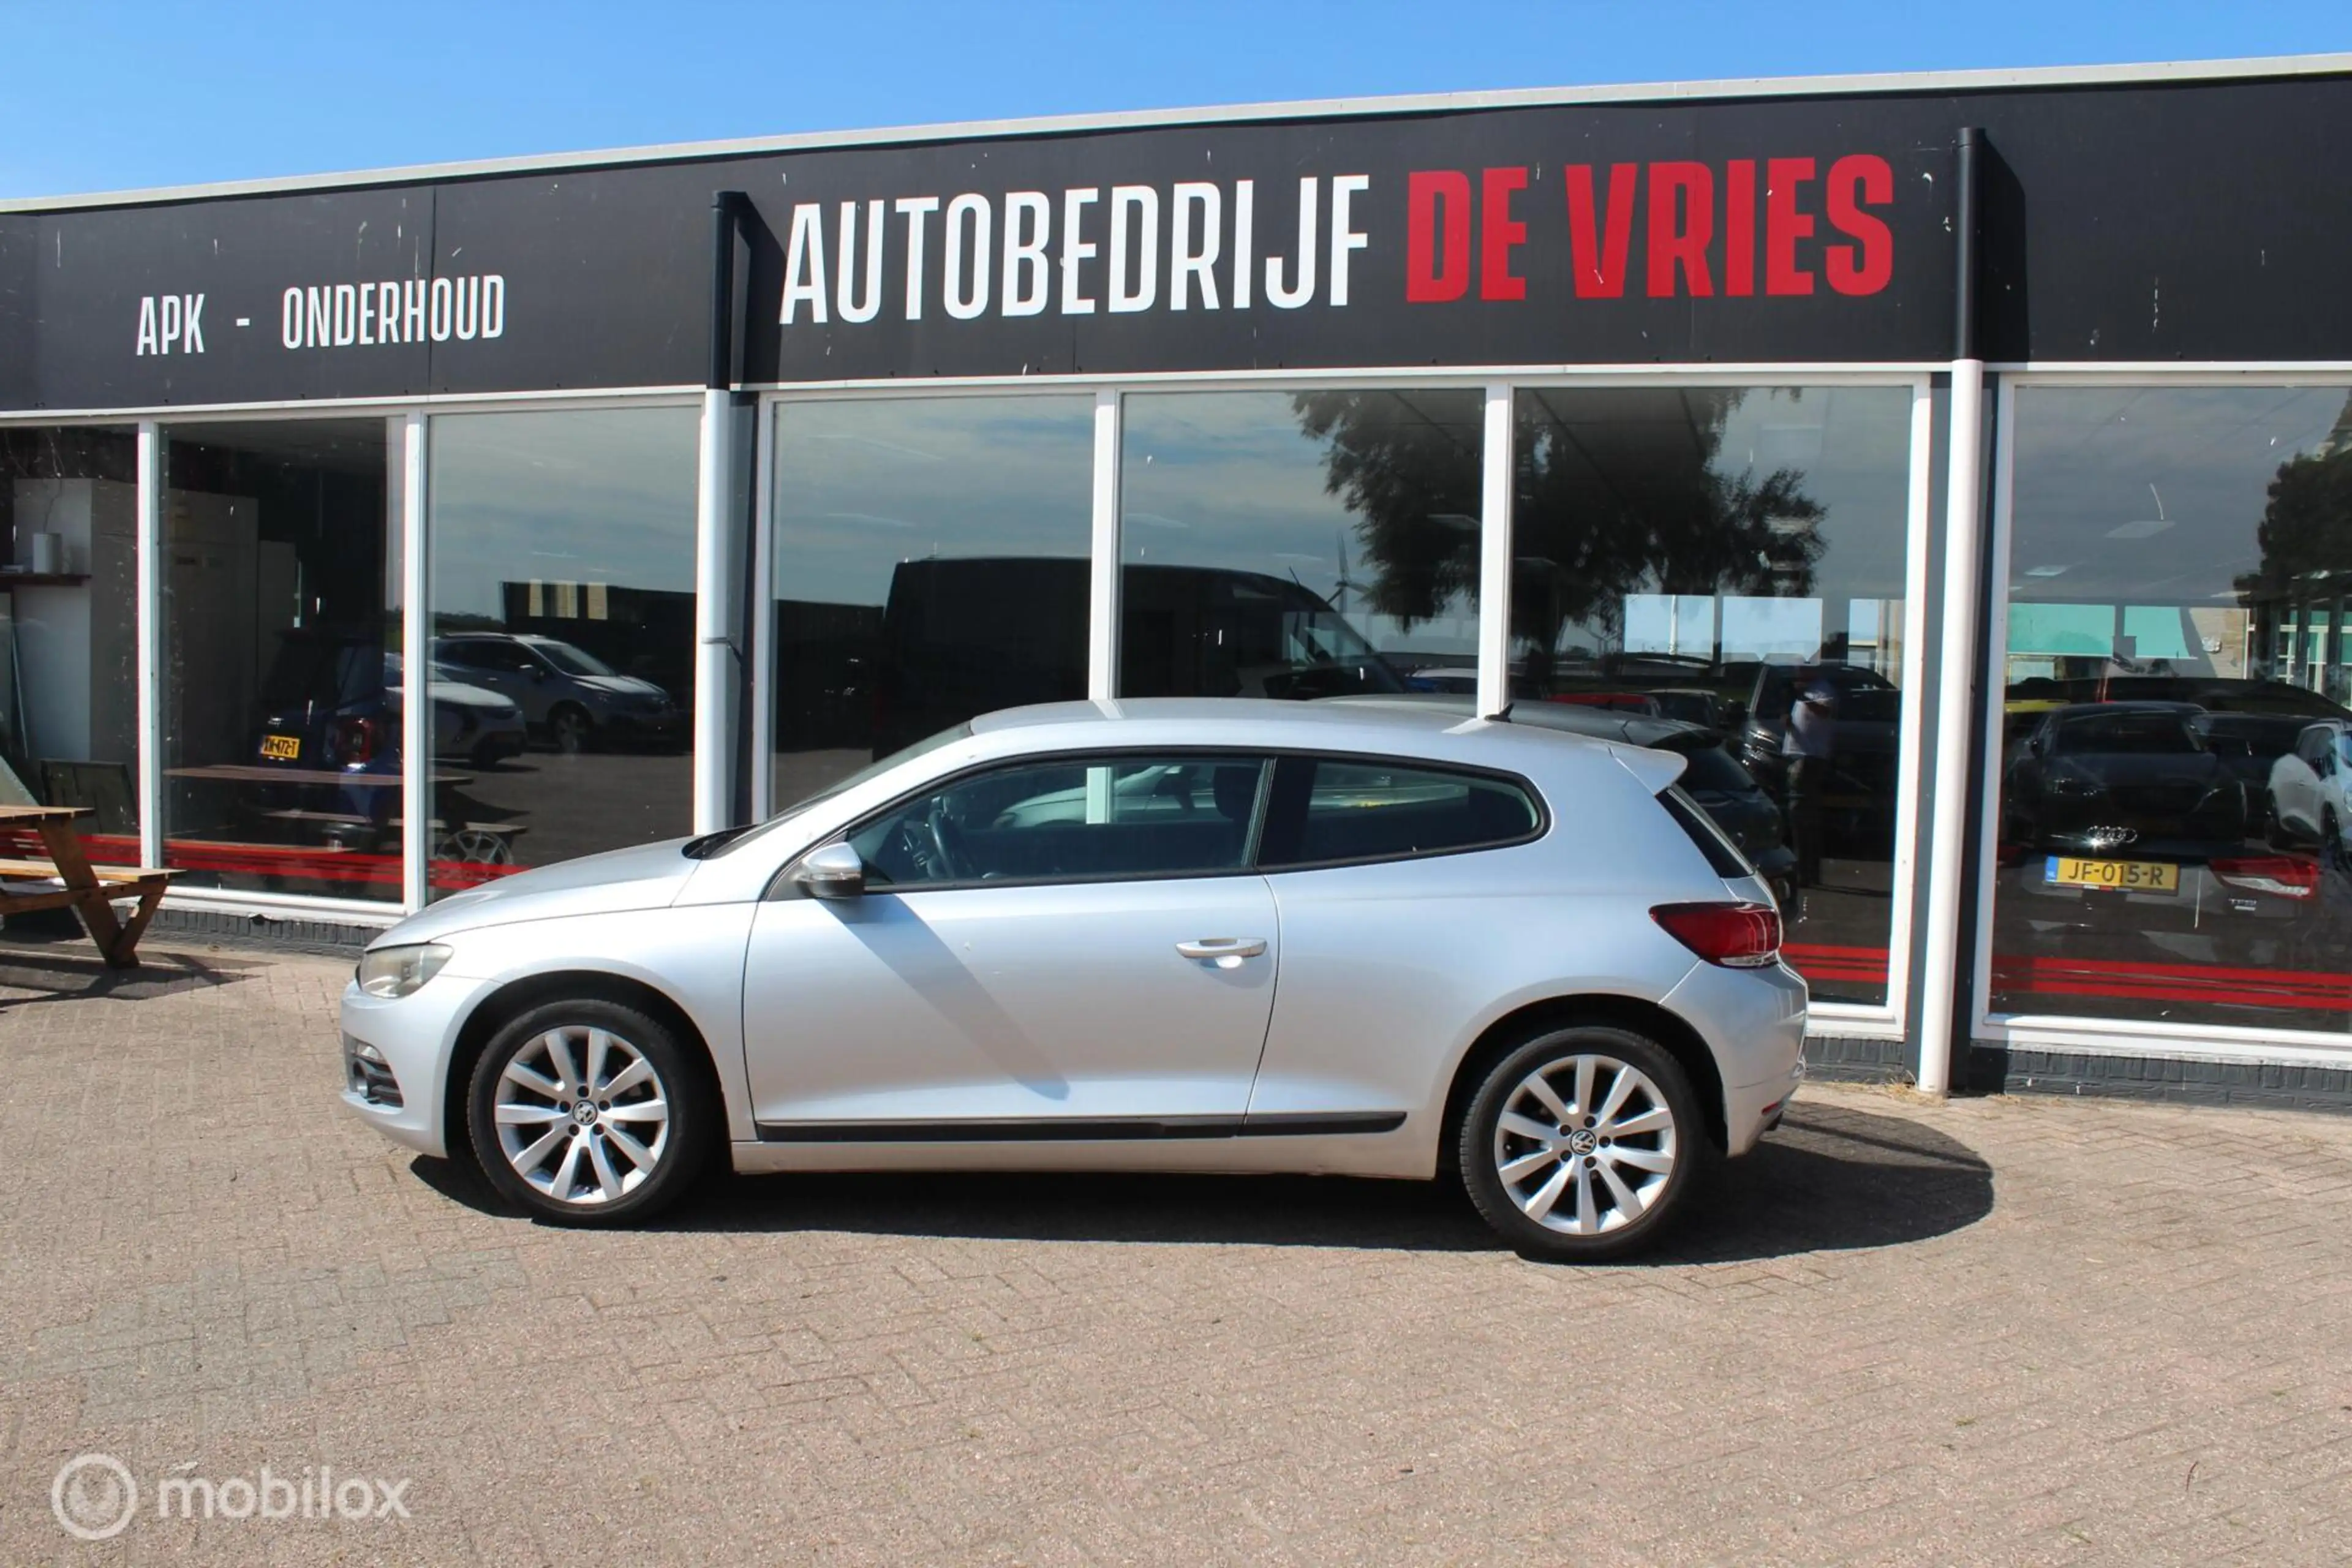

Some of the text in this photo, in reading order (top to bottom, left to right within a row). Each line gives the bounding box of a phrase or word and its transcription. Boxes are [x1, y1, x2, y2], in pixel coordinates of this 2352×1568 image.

[779, 154, 1893, 325] AUTOBEDRIJF DE VRIES
[137, 293, 205, 355] APK
[282, 274, 505, 349] ONDERHOUD
[2068, 862, 2163, 886] JF-015-R
